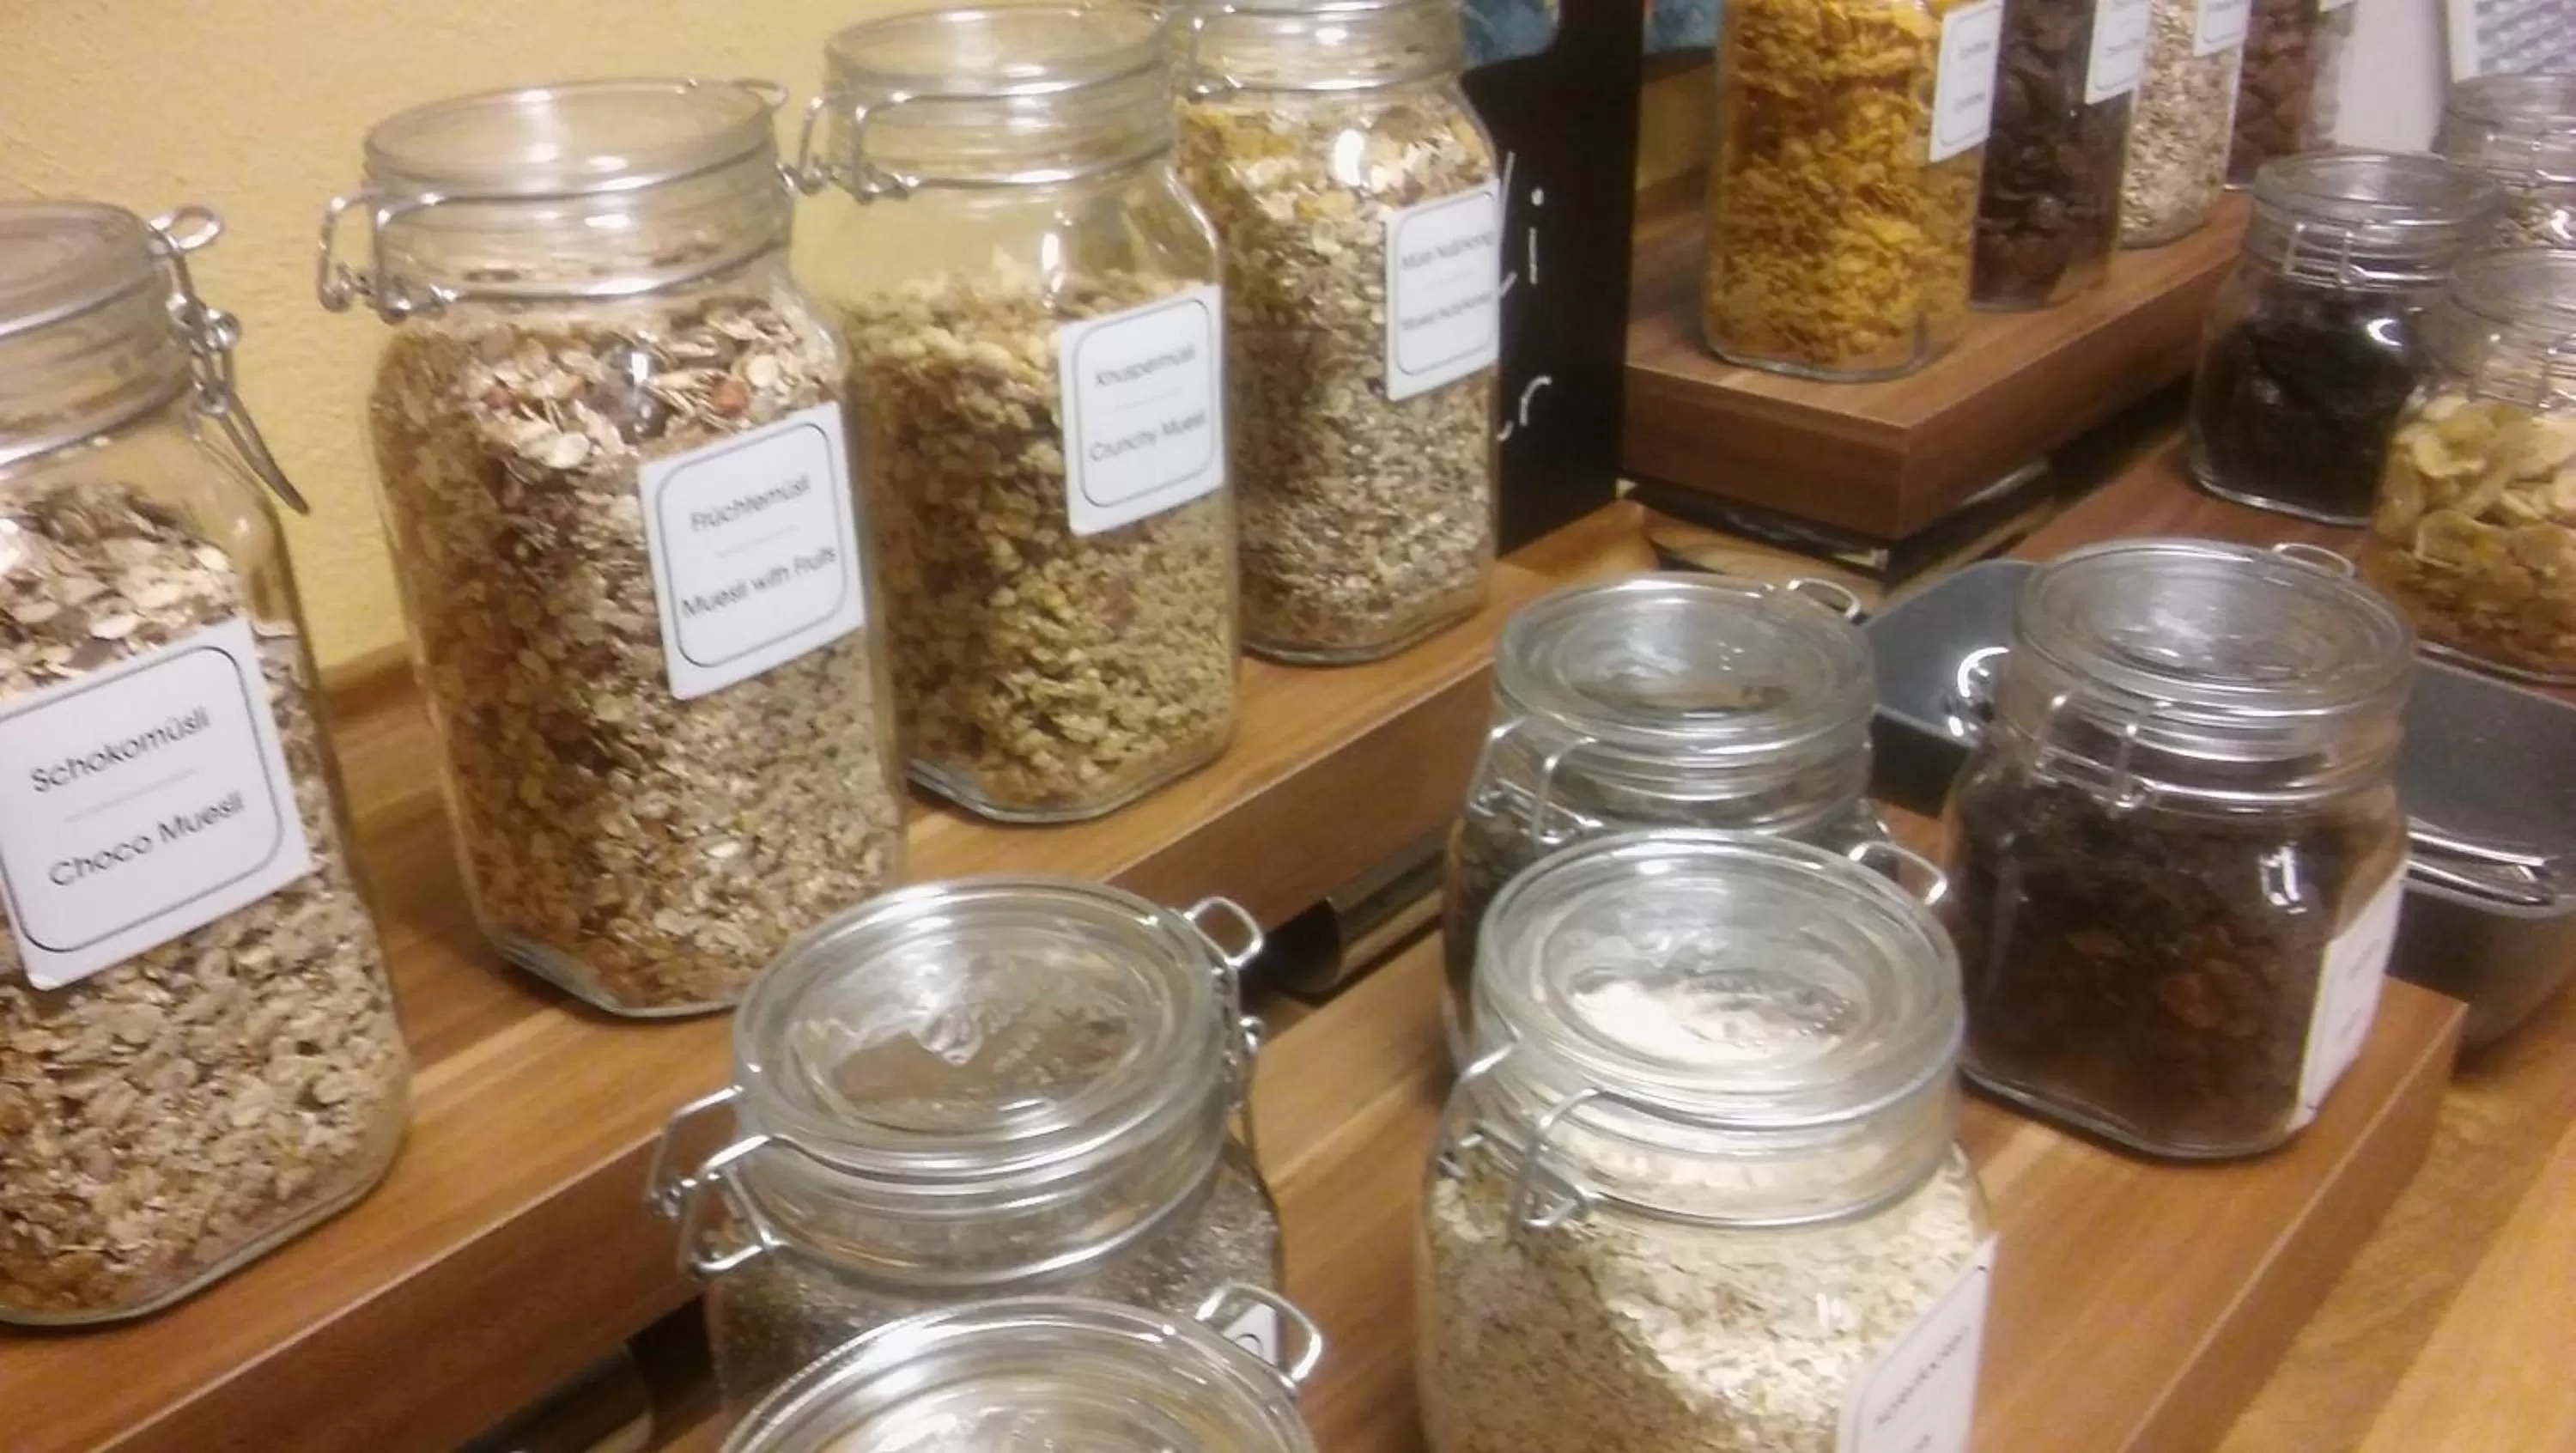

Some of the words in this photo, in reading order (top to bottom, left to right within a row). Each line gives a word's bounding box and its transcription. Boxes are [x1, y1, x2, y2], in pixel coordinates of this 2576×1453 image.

[30, 704, 212, 793] Schokomüsli
[48, 834, 154, 886] Choco
[157, 790, 246, 845] Muesli
